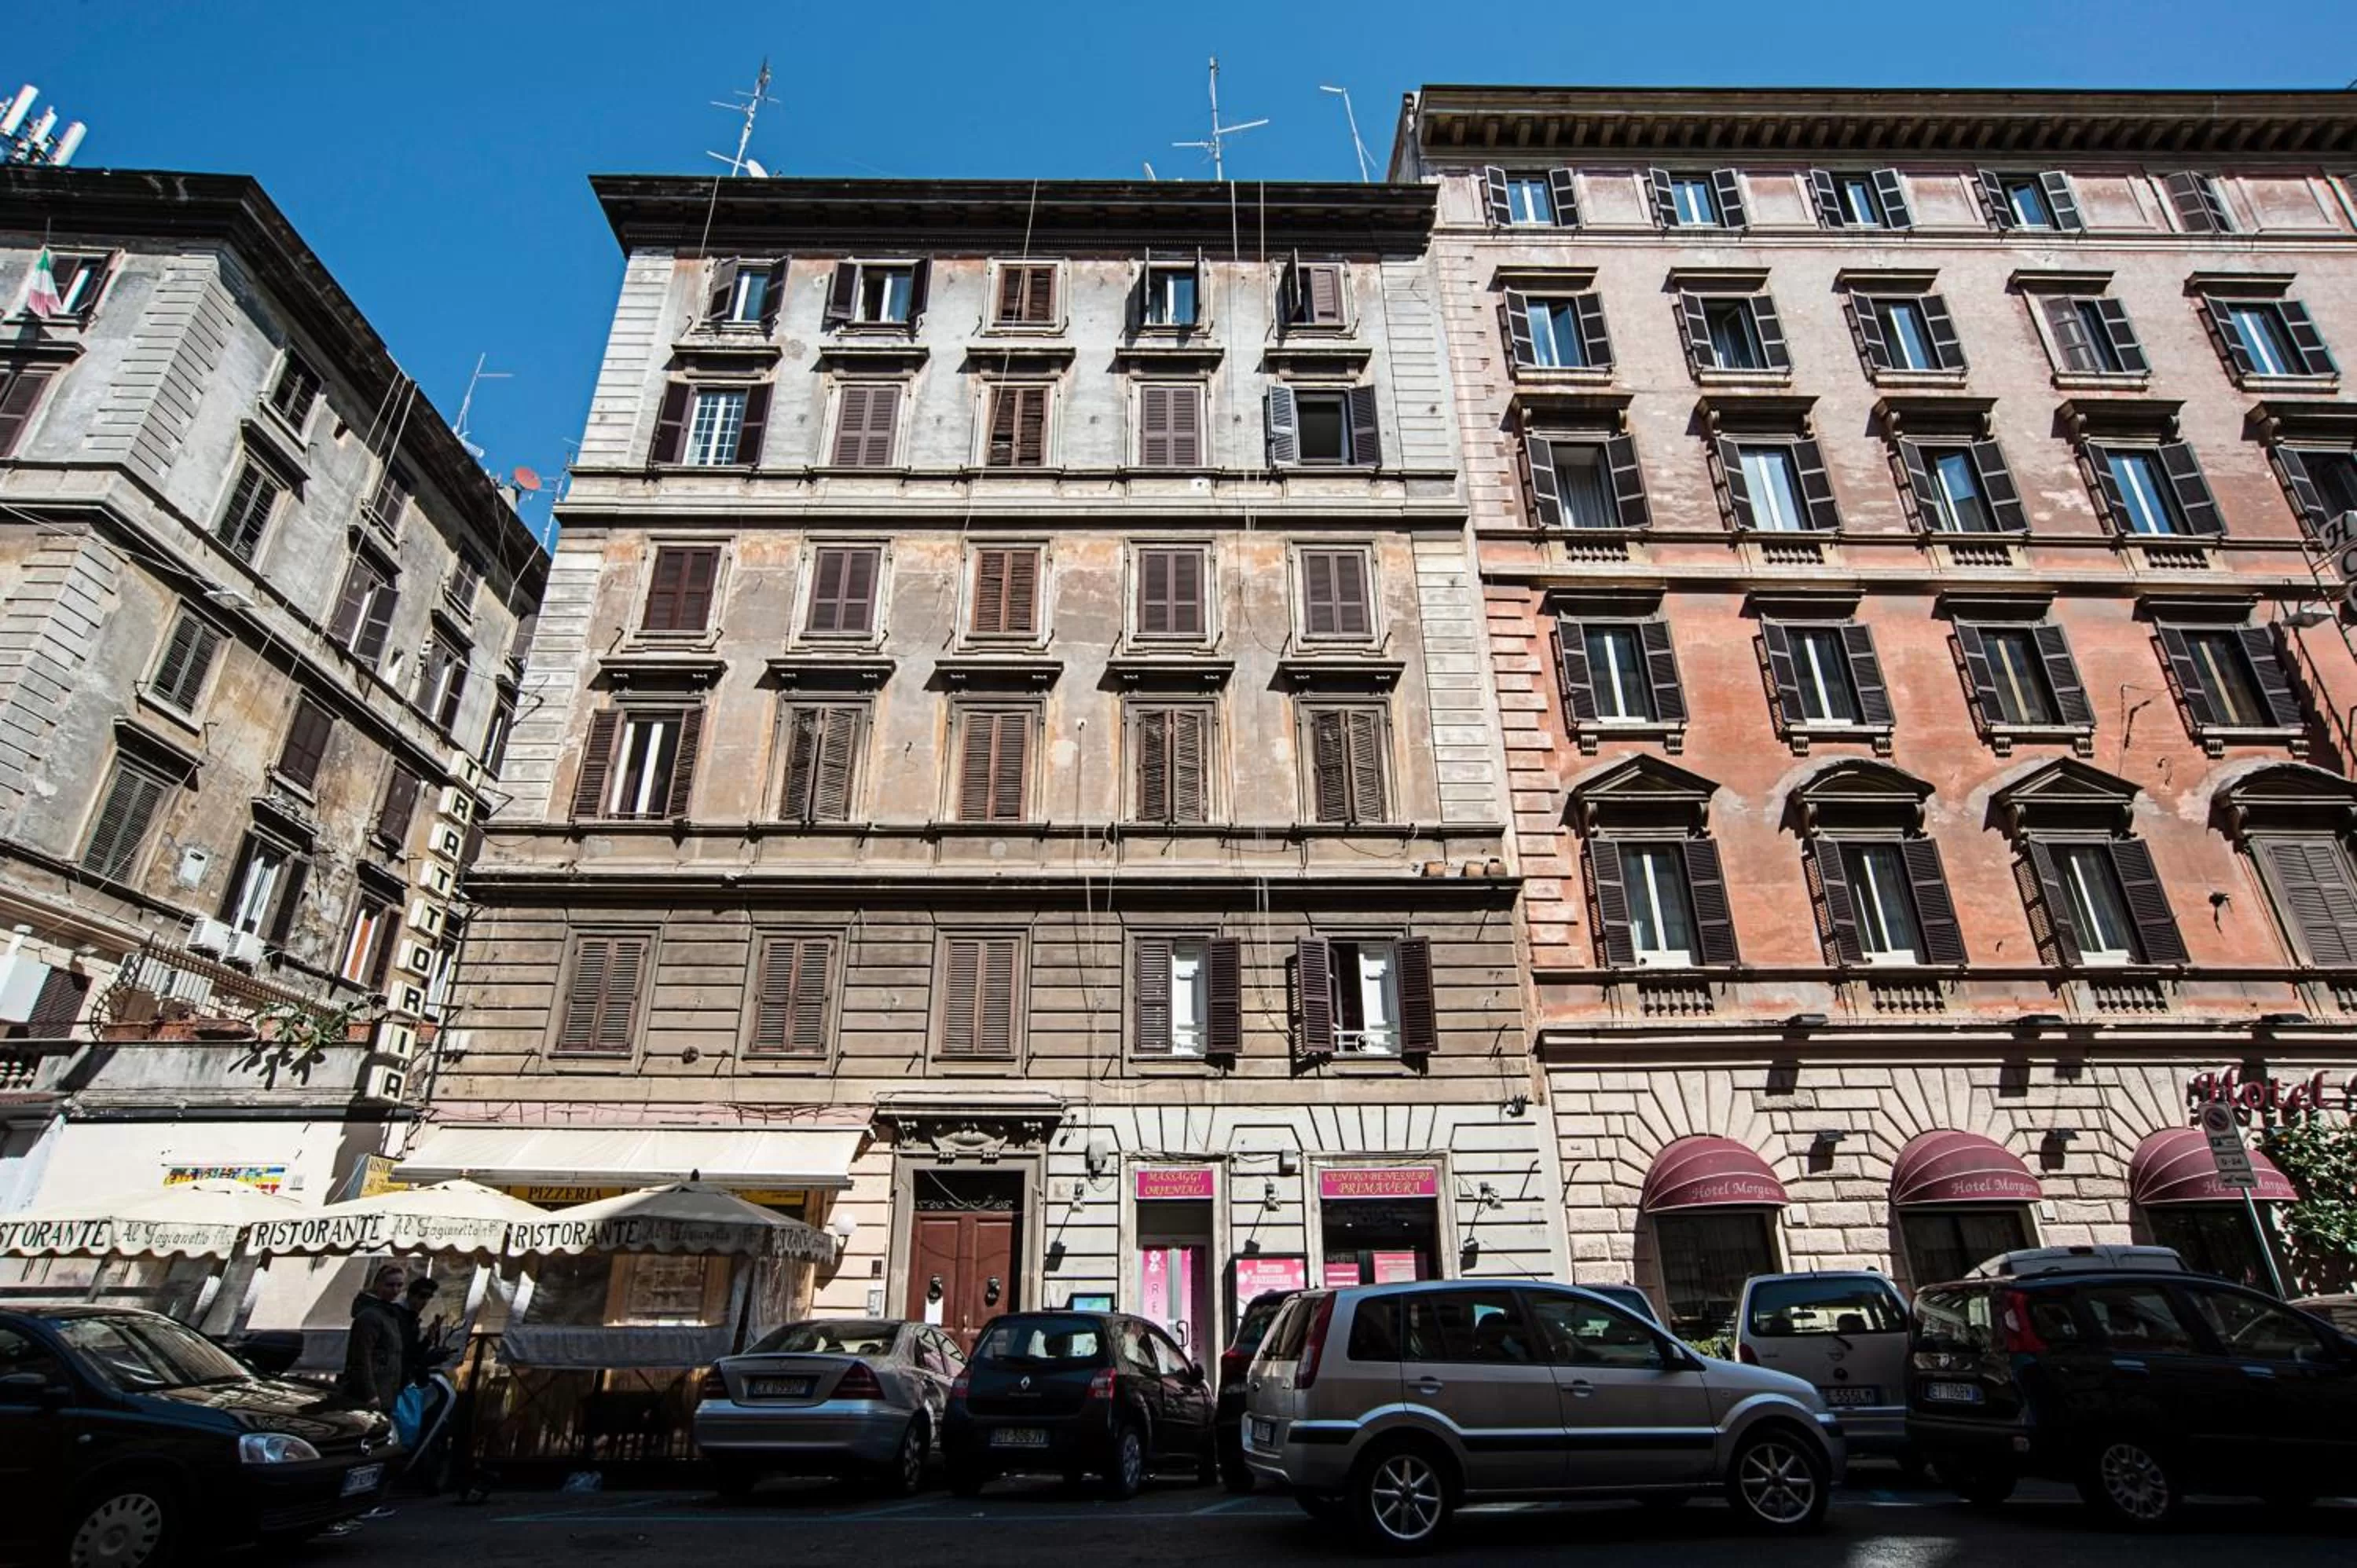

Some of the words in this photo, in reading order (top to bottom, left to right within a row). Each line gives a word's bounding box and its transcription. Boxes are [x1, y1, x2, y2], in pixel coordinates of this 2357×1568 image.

[383, 757, 478, 1098] TRATTORIA
[2187, 1064, 2330, 1109] Hotel
[1147, 1172, 1203, 1182] MASSAGGI
[1325, 1171, 1368, 1182] CENTRO
[1369, 1171, 1432, 1181] BENESSERE
[528, 1187, 602, 1200] PIZZERIA
[1144, 1185, 1205, 1195] ORIENTALI
[1337, 1181, 1420, 1195] PRIMAVERA
[1692, 1181, 1730, 1199] Hotel
[1952, 1177, 1991, 1195] Hotel
[254, 1214, 385, 1247] RISTORANTE
[515, 1218, 640, 1248] RISTORANTE
